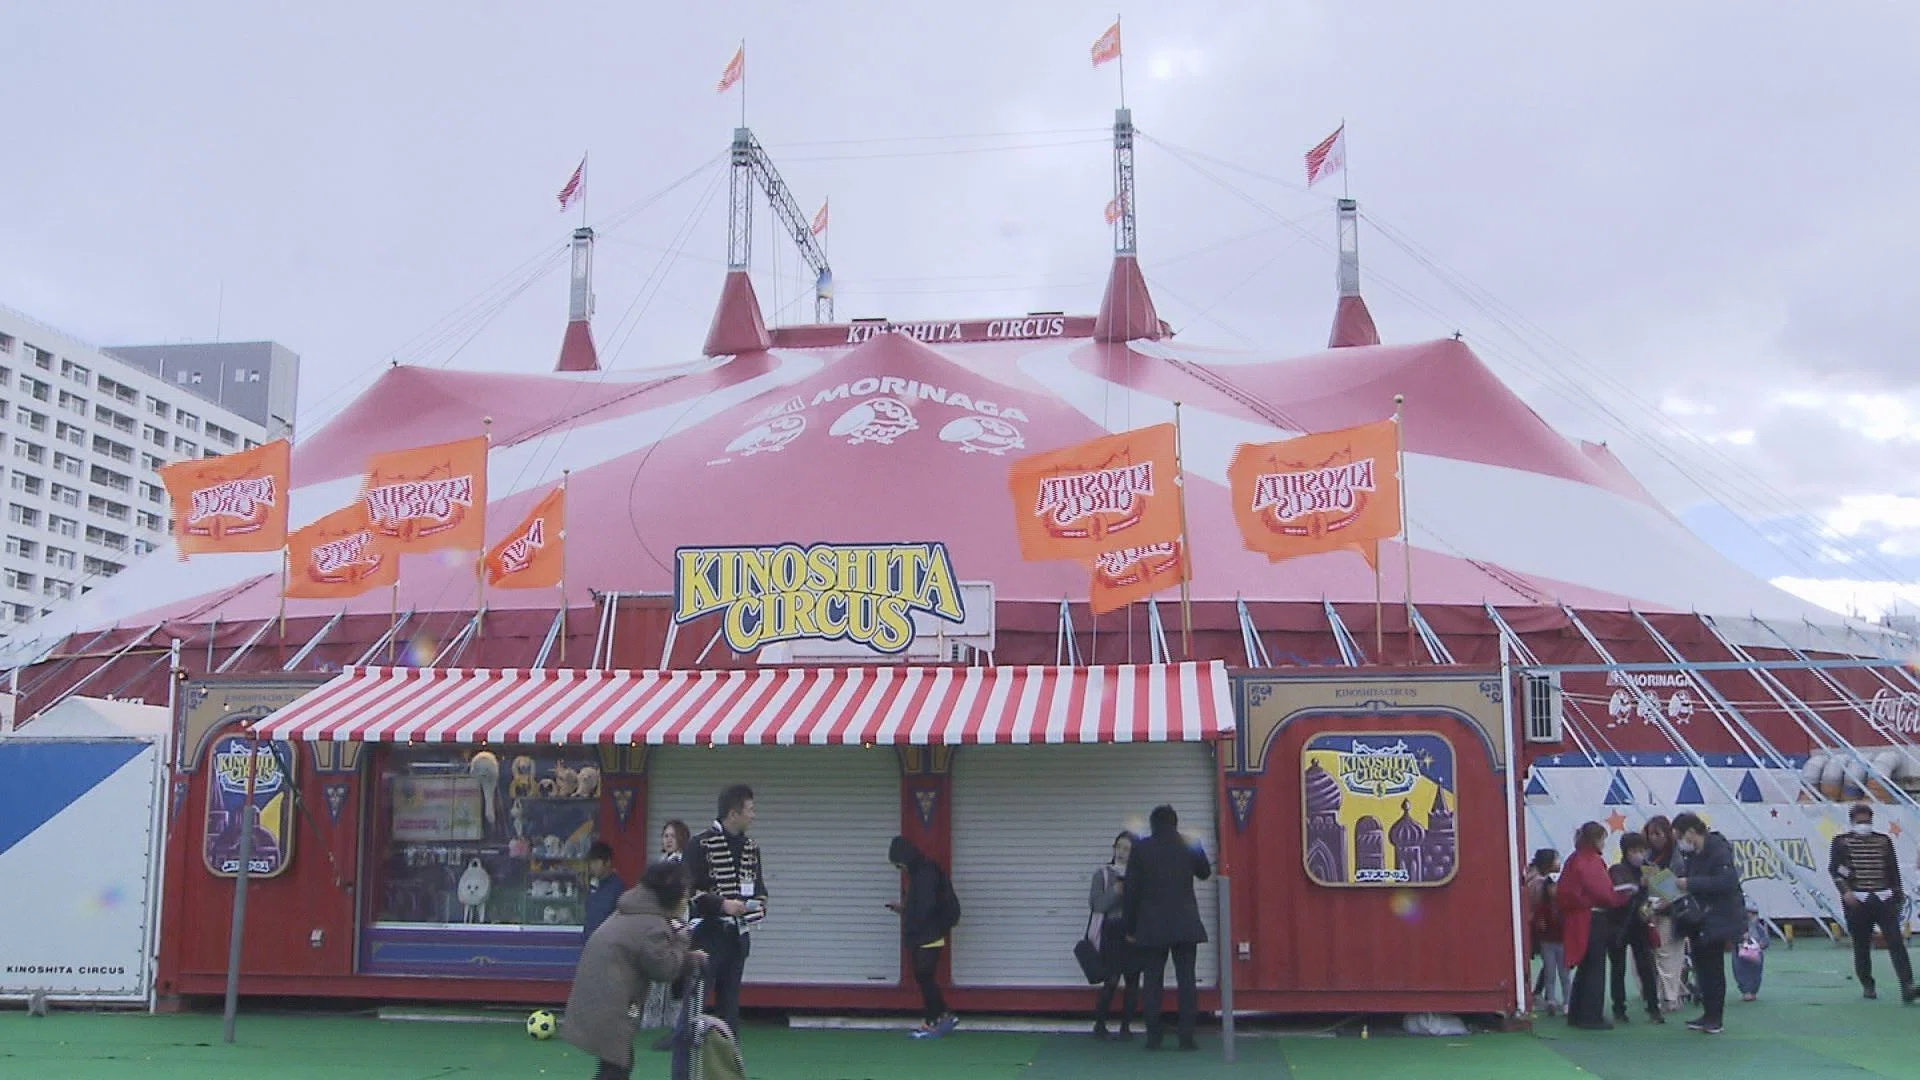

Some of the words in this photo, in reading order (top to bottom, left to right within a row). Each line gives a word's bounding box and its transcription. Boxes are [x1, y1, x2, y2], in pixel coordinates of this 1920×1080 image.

[847, 321, 962, 343] KINSHITA
[987, 317, 1065, 338] CIRCUS
[811, 376, 1029, 423] MORINAGA
[676, 544, 965, 621] KINOSHITA
[723, 590, 914, 652] CIRCUS
[1339, 754, 1421, 776] KINOSHITA
[1355, 766, 1406, 784] CIRCUS
[6, 965, 73, 974] KINOSHITA
[78, 965, 125, 975] CIRCUS
